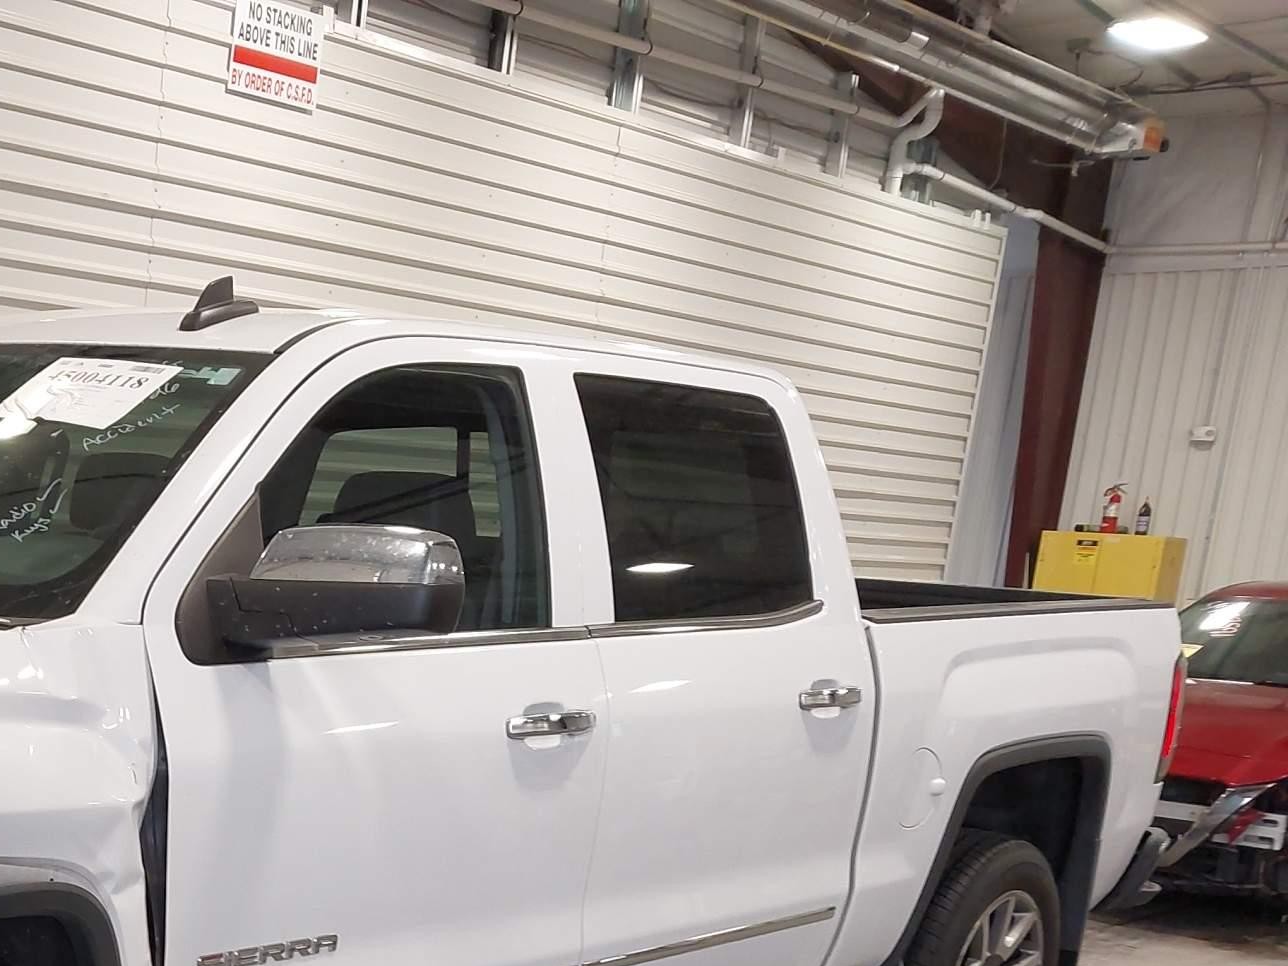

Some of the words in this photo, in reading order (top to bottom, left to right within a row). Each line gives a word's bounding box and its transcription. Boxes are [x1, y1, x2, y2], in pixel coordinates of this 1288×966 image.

[249, 1, 263, 21] NO
[265, 7, 313, 36] STACKING
[238, 21, 271, 47] ABOVE
[274, 31, 296, 54] THIS
[297, 38, 318, 61] LINE
[231, 68, 244, 86] BY
[244, 72, 272, 94] ORDER
[274, 79, 286, 97] OF
[286, 83, 314, 106] C.S.F.D.
[48, 370, 150, 389] 45004118
